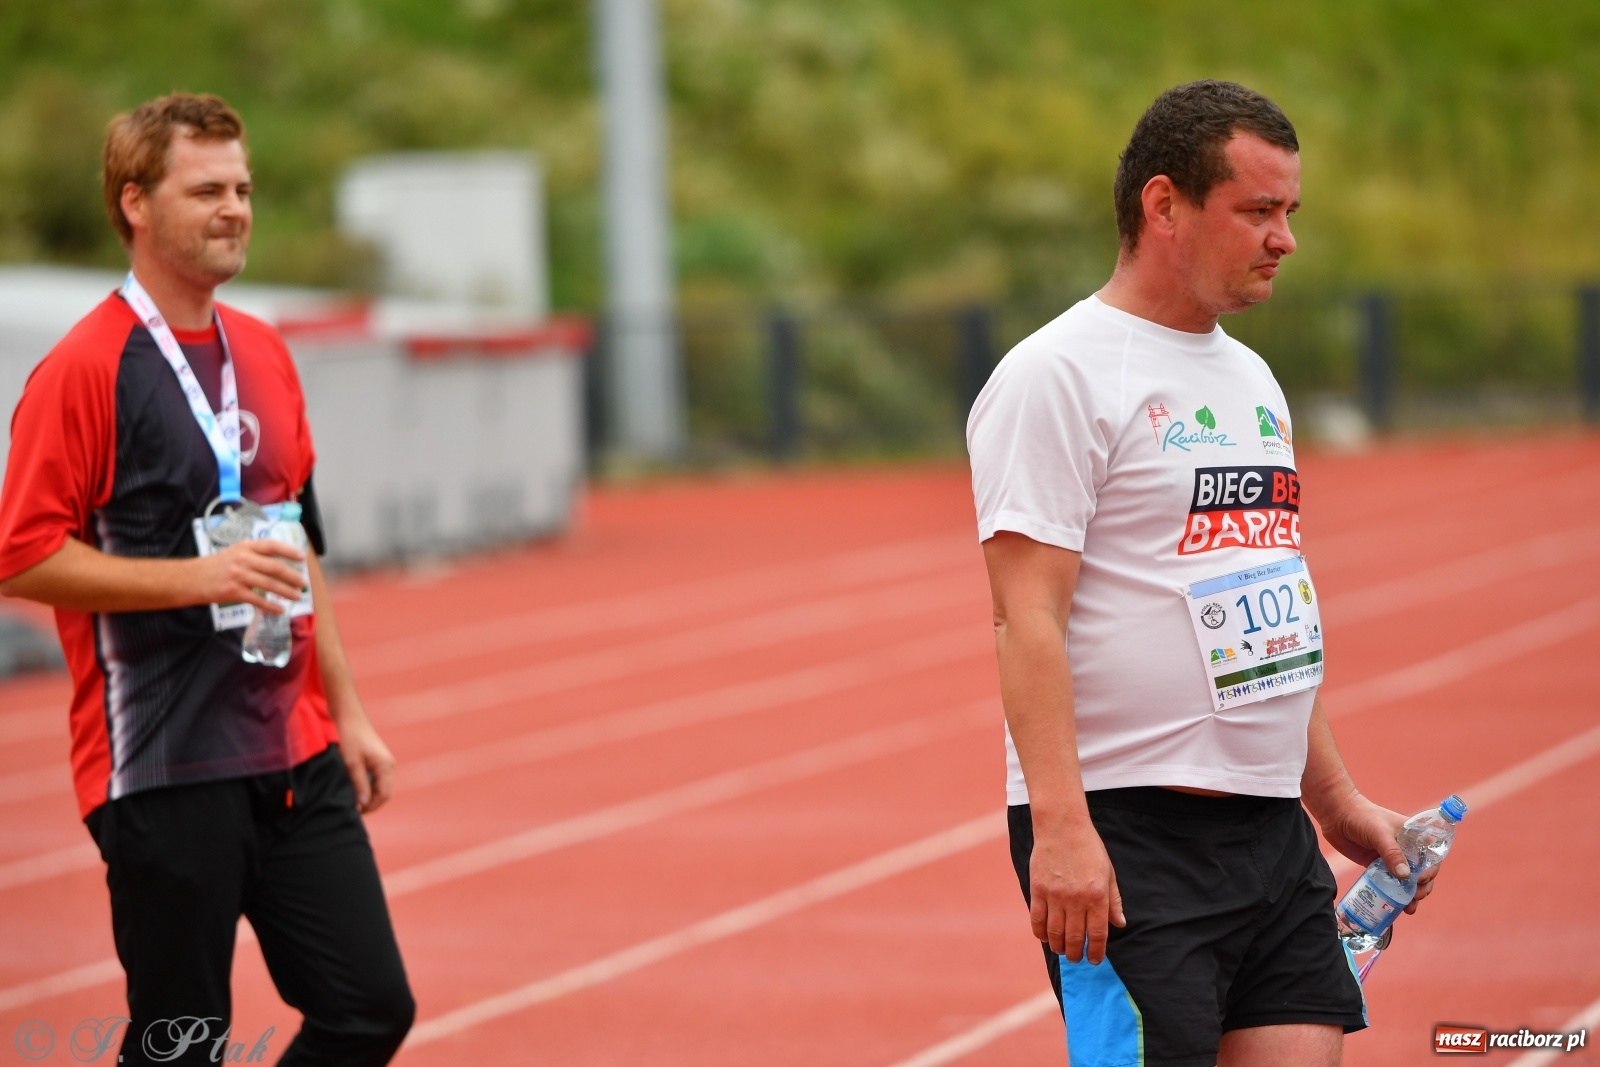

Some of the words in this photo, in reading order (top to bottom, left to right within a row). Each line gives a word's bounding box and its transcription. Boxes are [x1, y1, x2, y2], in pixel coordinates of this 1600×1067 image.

[1197, 471, 1263, 505] BIEG
[1244, 572, 1257, 580] Bieg
[1257, 569, 1266, 577] Bez
[1267, 565, 1281, 575] Barier
[1236, 584, 1300, 635] 102
